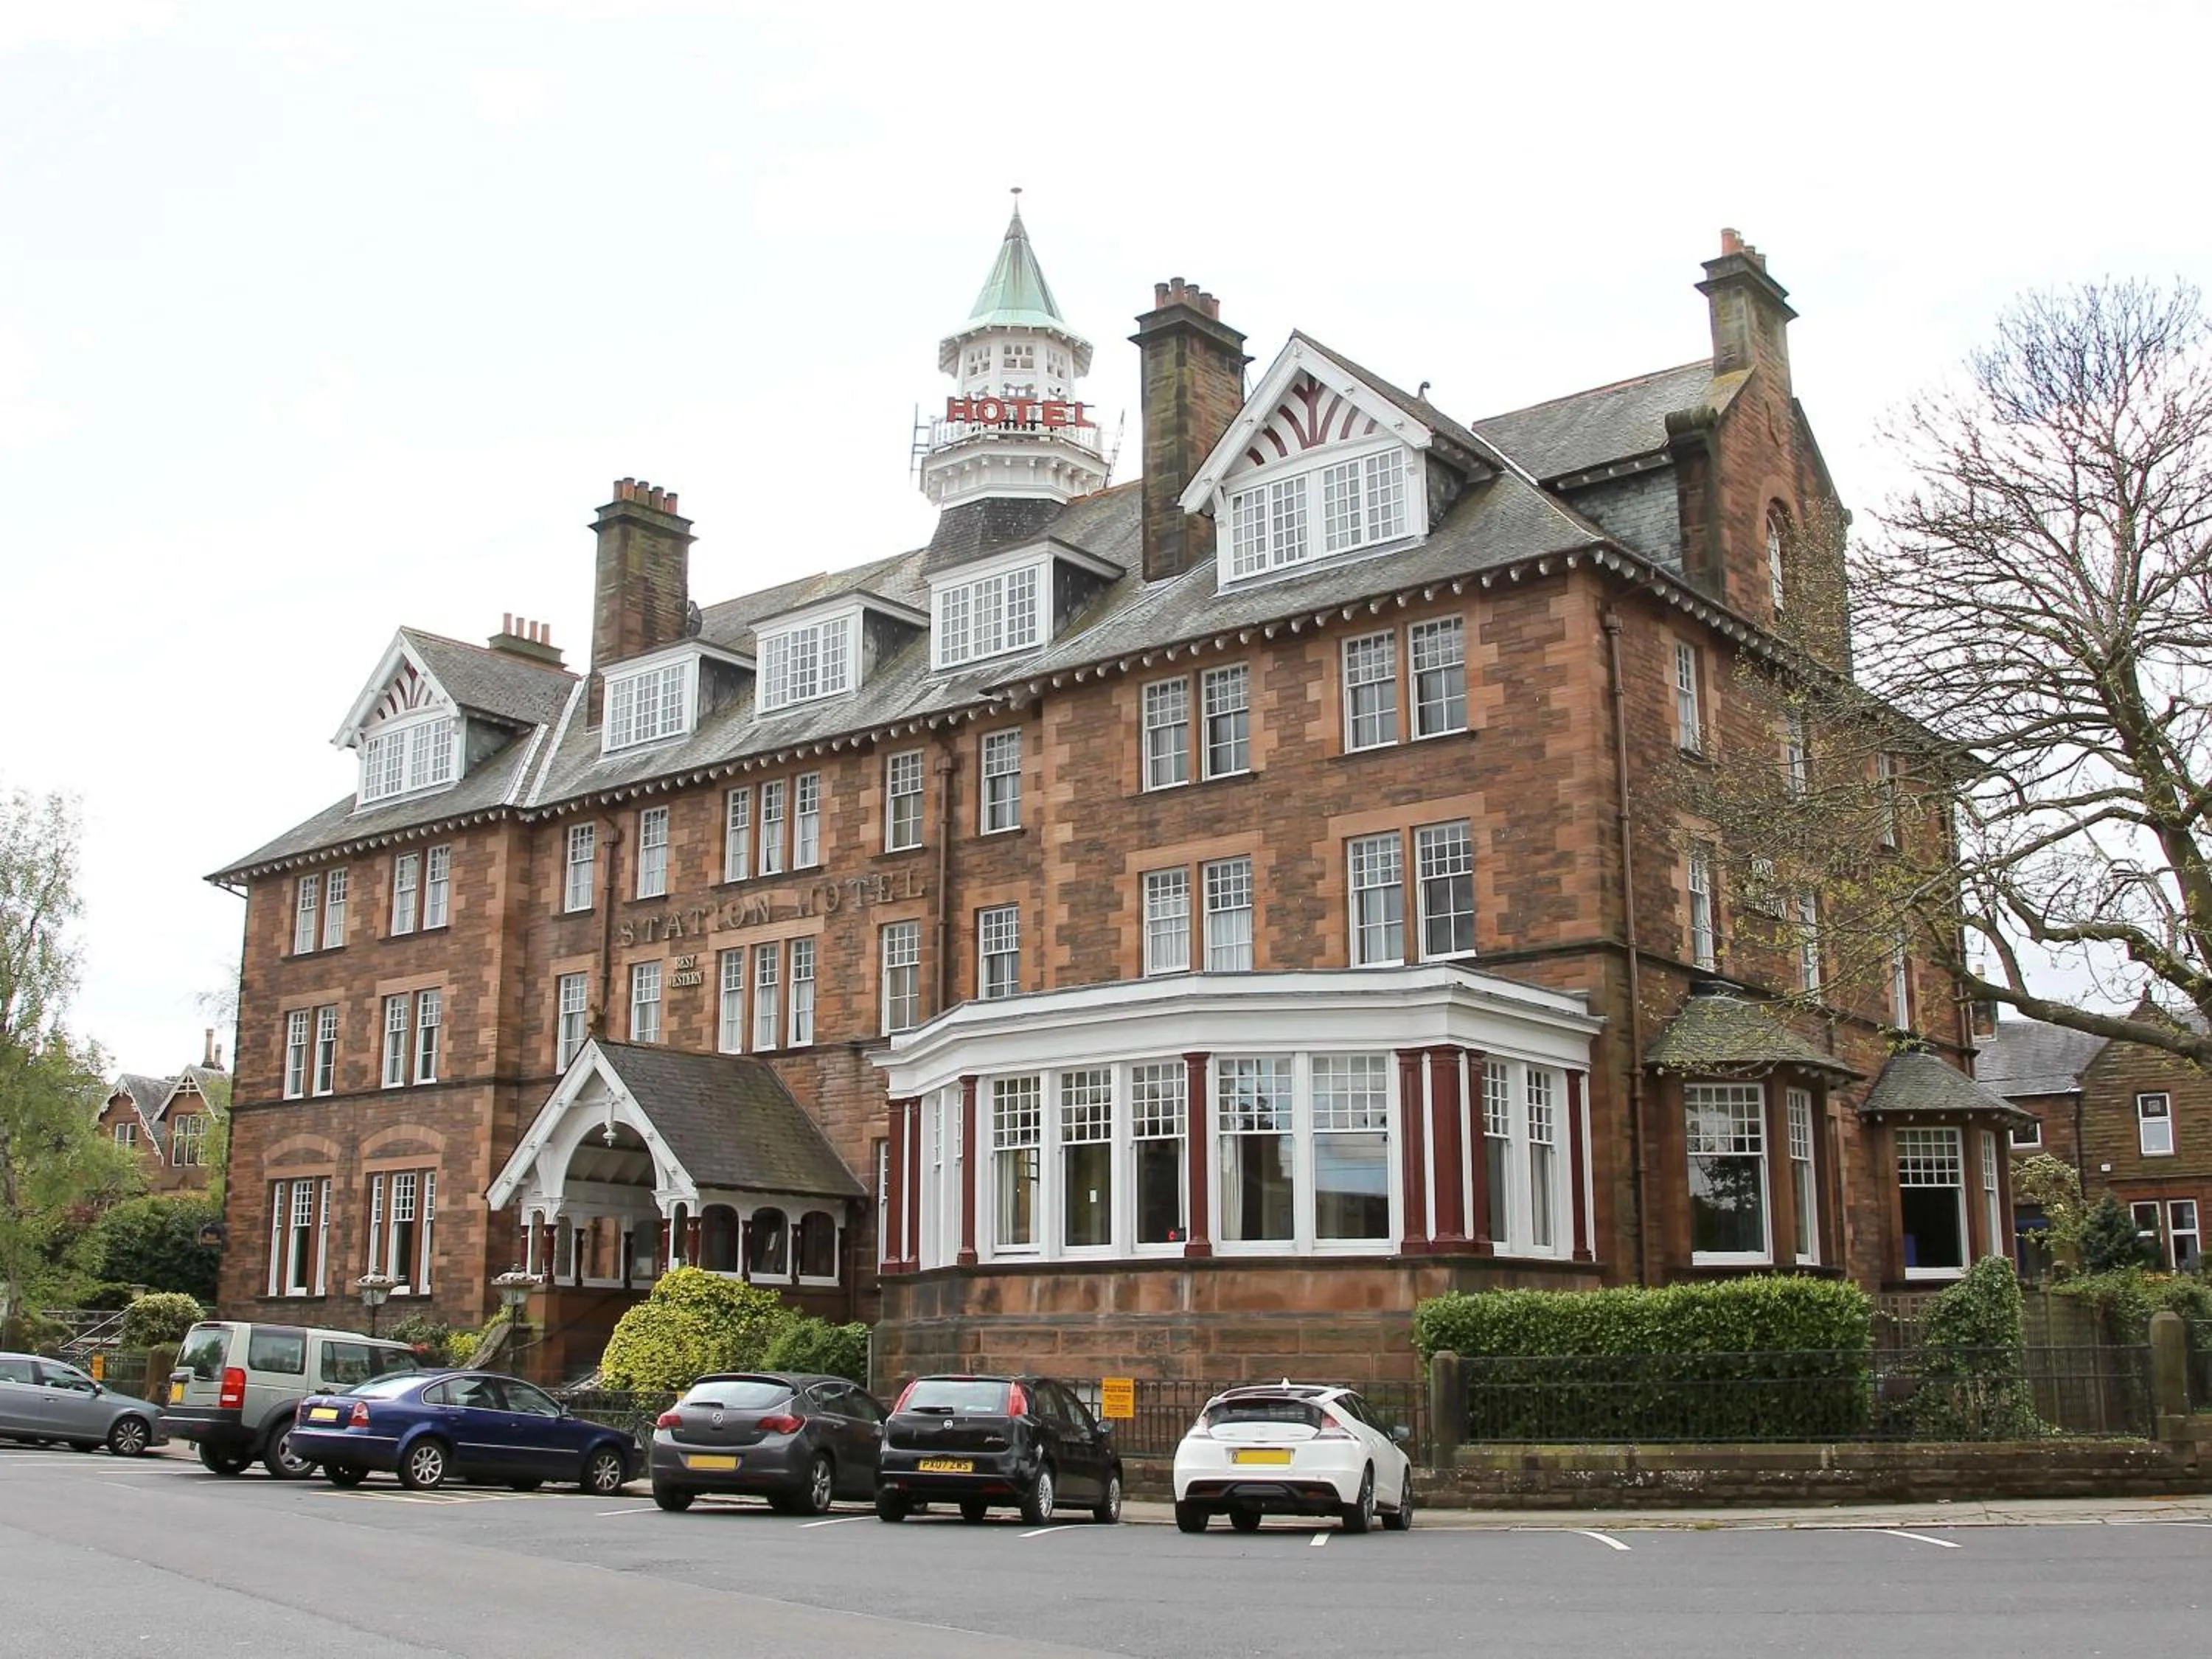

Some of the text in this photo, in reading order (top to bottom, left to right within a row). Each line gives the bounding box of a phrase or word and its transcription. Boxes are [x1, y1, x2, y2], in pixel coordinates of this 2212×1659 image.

[947, 397, 1096, 428] HOTEL
[619, 869, 926, 947] STATION HOTEL
[675, 955, 695, 970] BEST
[666, 971, 703, 987] WESTERN
